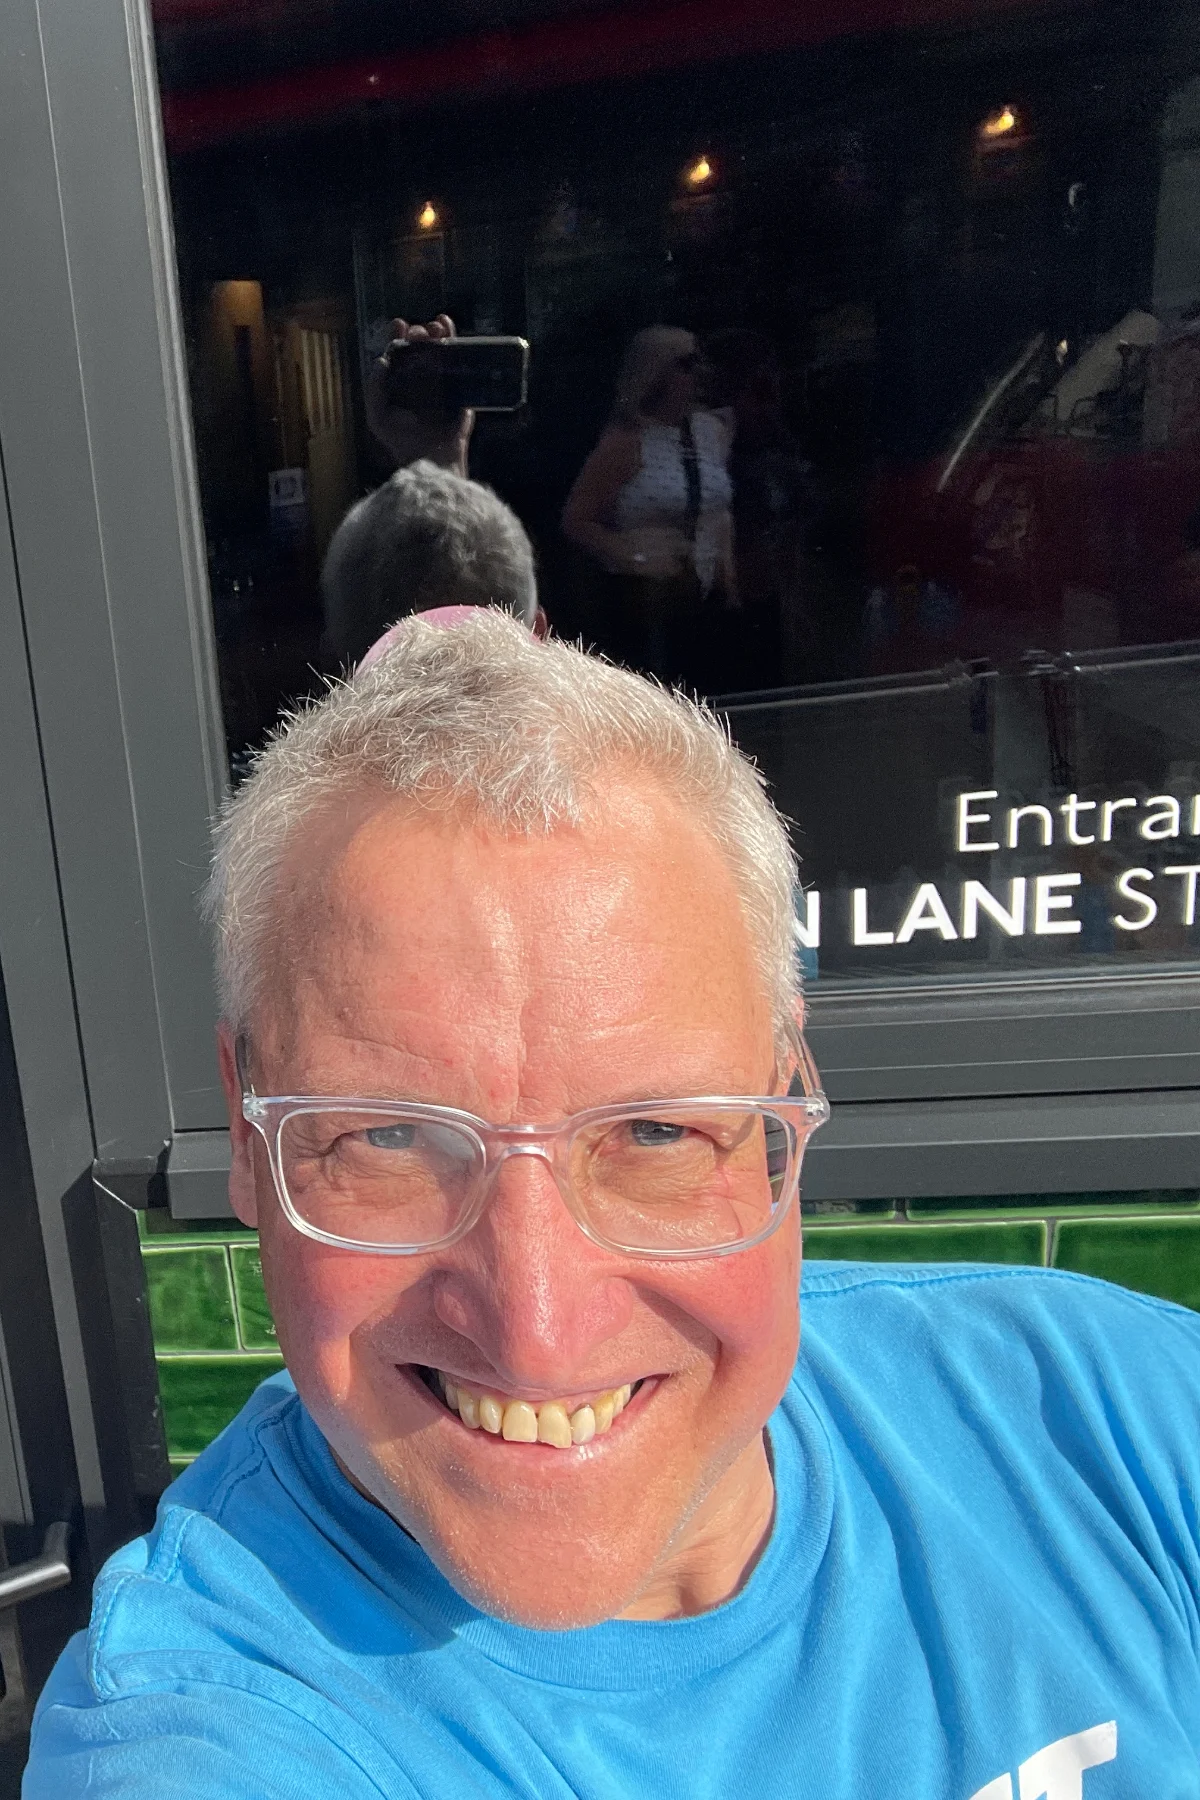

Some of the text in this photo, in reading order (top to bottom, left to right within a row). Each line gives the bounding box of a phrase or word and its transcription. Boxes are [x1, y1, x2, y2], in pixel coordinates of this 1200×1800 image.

[956, 789, 1200, 853] Entra
[853, 872, 1082, 947] LANE
[1114, 865, 1200, 931] ST
